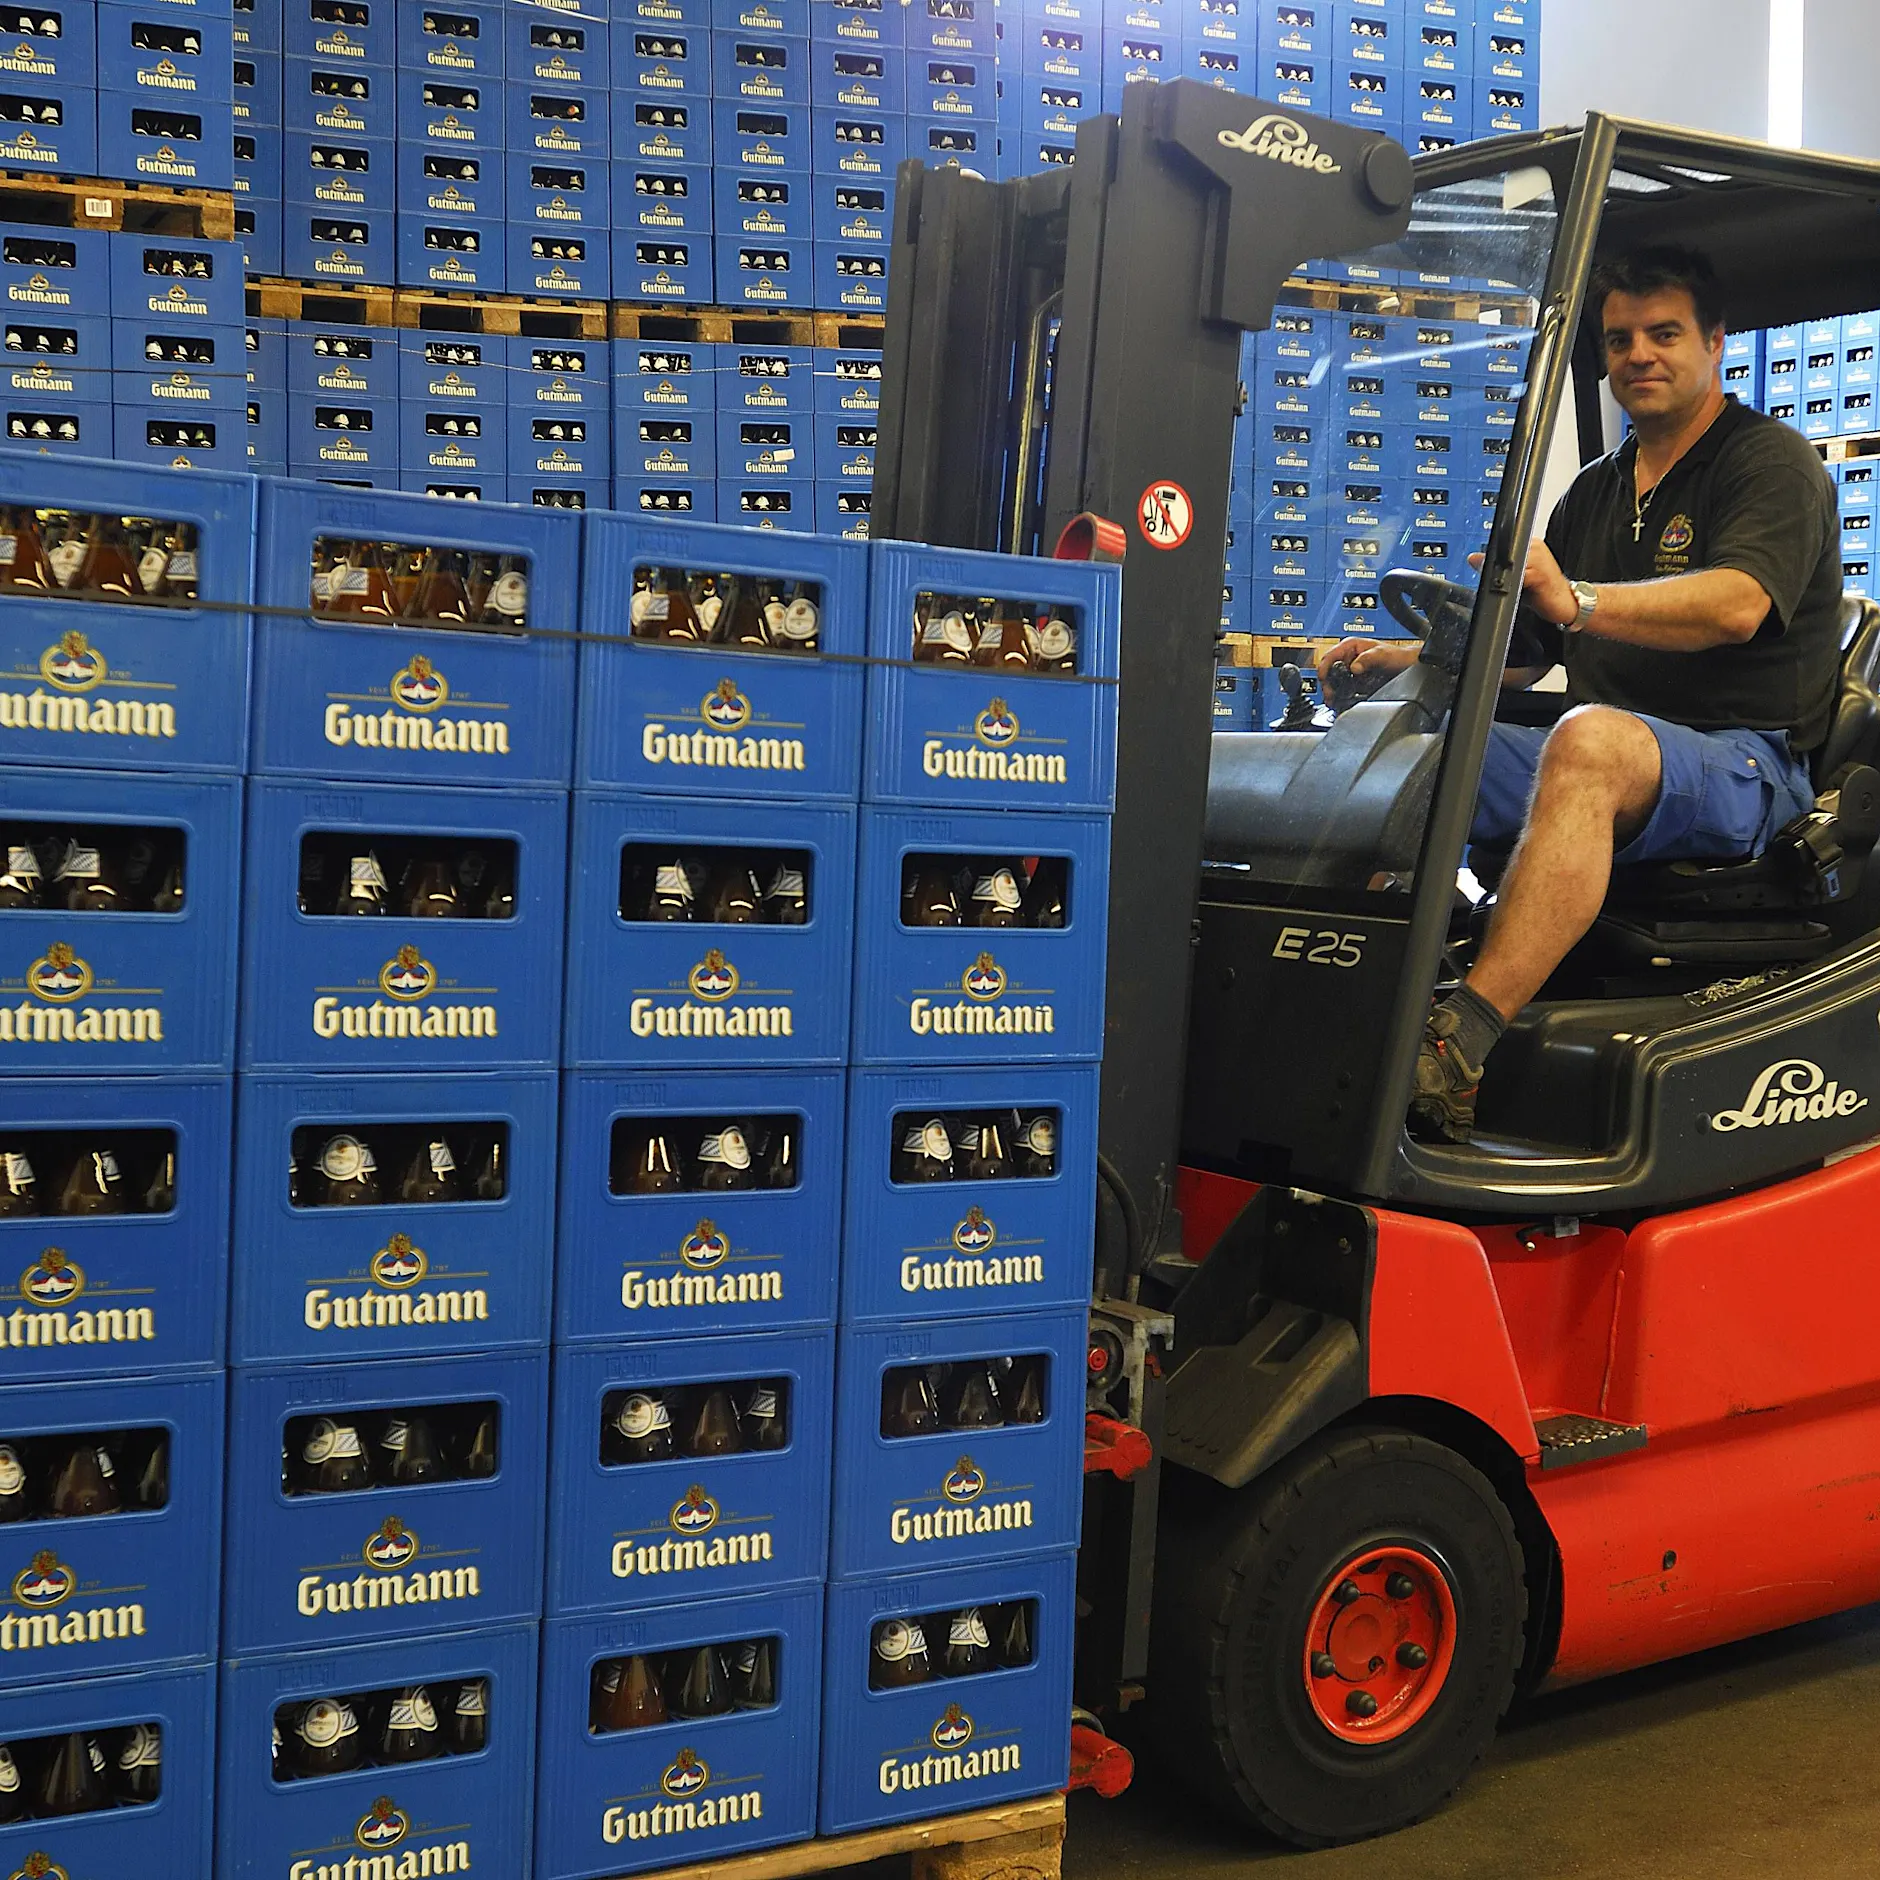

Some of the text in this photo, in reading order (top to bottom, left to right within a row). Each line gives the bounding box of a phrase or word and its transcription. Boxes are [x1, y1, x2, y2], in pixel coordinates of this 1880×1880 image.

[637, 4, 683, 20] Gutmann
[1045, 4, 1080, 19] Gutmann
[740, 14, 783, 29] Gutmann
[837, 23, 879, 39] Gutmann
[315, 40, 365, 58] Gutmann
[932, 33, 972, 49] Gutmann
[427, 52, 475, 69] Gutmann
[1044, 61, 1079, 76] Gutmann
[137, 71, 196, 91] Gutmann
[535, 66, 581, 81] Gutmann
[639, 73, 684, 89] Gutmann
[741, 83, 784, 98] Gutmann
[838, 91, 880, 107] Gutmann
[933, 100, 973, 114] Gutmann
[315, 114, 365, 131] Gutmann
[427, 123, 475, 141] Gutmann
[535, 135, 581, 152] Gutmann
[639, 143, 684, 158] Gutmann
[1218, 115, 1341, 174] Linde
[742, 151, 785, 166] Gutmann
[840, 158, 881, 173] Gutmann
[137, 157, 196, 177] Gutmann
[315, 186, 365, 203] Gutmann
[428, 195, 476, 212] Gutmann
[536, 206, 582, 221] Gutmann
[639, 212, 684, 227] Gutmann
[743, 219, 786, 233] Gutmann
[841, 226, 882, 240] Gutmann
[314, 259, 364, 276] Gutmann
[429, 266, 477, 283] Gutmann
[535, 276, 581, 291] Gutmann
[641, 281, 685, 295] Gutmann
[8, 285, 71, 305] Gutmann
[744, 287, 788, 300] Gutmann
[840, 292, 882, 305] Gutmann
[148, 298, 208, 315] Gutmann
[11, 374, 74, 392] Gutmann
[318, 375, 368, 390] Gutmann
[429, 382, 477, 397] Gutmann
[151, 383, 211, 400] Gutmann
[536, 389, 583, 403] Gutmann
[643, 391, 688, 404] Gutmann
[744, 394, 788, 407] Gutmann
[319, 448, 369, 462] Gutmann
[428, 454, 476, 468] Gutmann
[1276, 454, 1308, 467] Gutmann
[536, 459, 583, 472] Gutmann
[644, 460, 689, 473] Gutmann
[745, 462, 788, 473] Gutmann
[1348, 460, 1380, 472] Gutmann
[1416, 464, 1448, 475] Gutmann
[1274, 509, 1307, 522] Gutmann
[1346, 513, 1378, 525] Gutmann
[1415, 516, 1446, 528] Gutmann
[1273, 563, 1306, 576] Gutmann
[1345, 567, 1377, 579] Gutmann
[1271, 619, 1304, 630] Gutmann
[1343, 622, 1375, 633] Gutmann
[0, 687, 176, 738] utmann
[324, 703, 510, 754] Gutmann
[642, 723, 805, 770] Gutmann
[923, 741, 1067, 784] Gutmann
[1271, 927, 1367, 968] E25
[313, 997, 498, 1039] Gutmann
[630, 998, 793, 1037] Gutmann
[910, 998, 1055, 1035] Gutmann
[1711, 1059, 1868, 1132] Linde
[901, 1254, 1044, 1292] Gutmann
[621, 1271, 784, 1309] Gutmann
[304, 1289, 489, 1330] Gutmann
[0, 1306, 156, 1348] tmann
[890, 1500, 1033, 1544] Gutmann
[611, 1531, 774, 1578] Gutmann
[297, 1566, 481, 1616] Gutmann
[878, 1744, 1021, 1794] Gutmann
[602, 1790, 763, 1844] Gutmann
